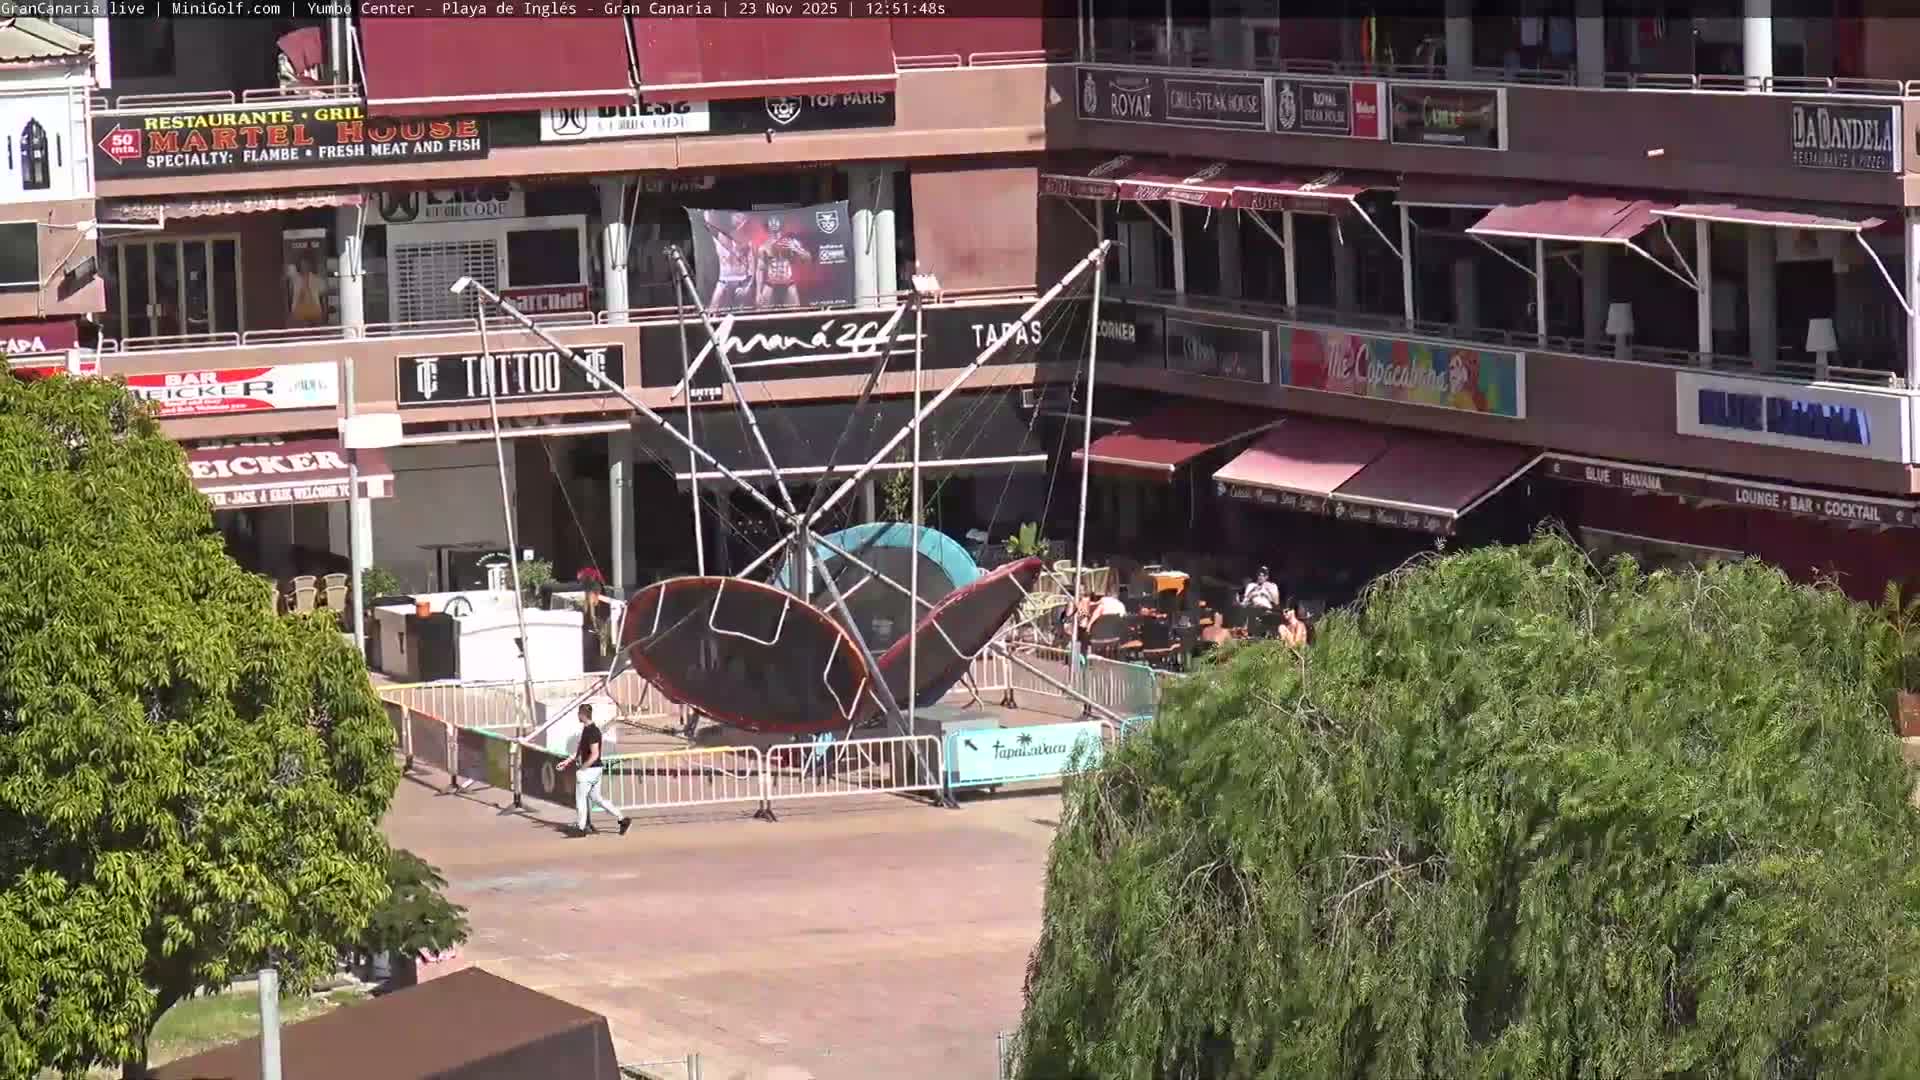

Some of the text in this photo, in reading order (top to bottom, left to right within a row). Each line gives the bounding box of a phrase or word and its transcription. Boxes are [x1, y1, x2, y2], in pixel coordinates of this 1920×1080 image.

[144, 106, 365, 130] RESTAURANTE GRIL
[112, 134, 133, 145] 50
[149, 119, 480, 154] MARTEL HOUSE
[146, 138, 480, 168] SPECIALTY: FLAMBE FRESH MEAT AND FISH
[971, 321, 1042, 348] TAPAS
[165, 372, 216, 386] BAR
[462, 352, 560, 397] TATTOO
[190, 451, 349, 479] EICKER
[1585, 466, 1662, 489] BLUE HAVANA
[1736, 488, 1881, 521] LOUNGE BAR COCKTAIL
